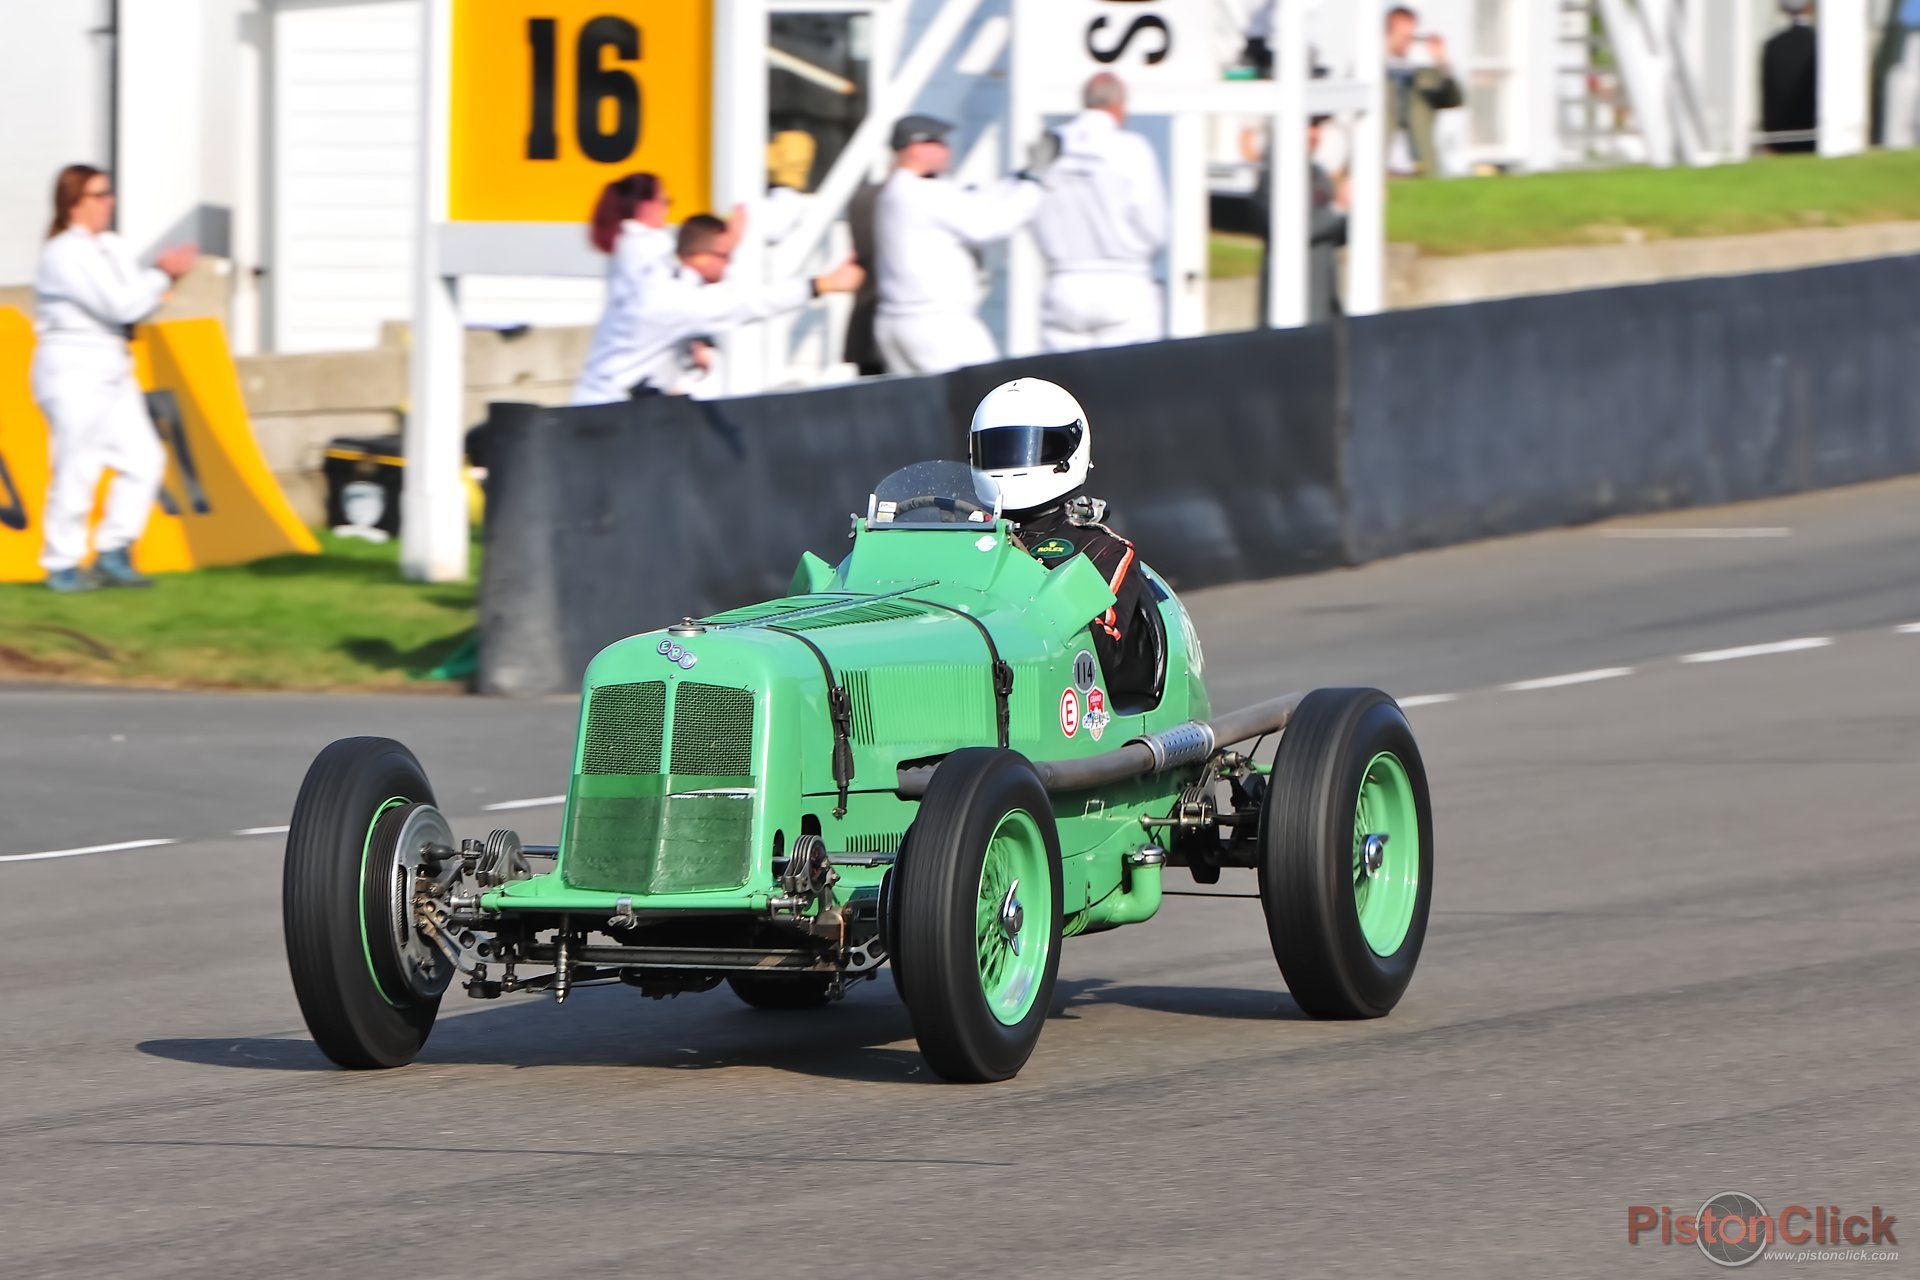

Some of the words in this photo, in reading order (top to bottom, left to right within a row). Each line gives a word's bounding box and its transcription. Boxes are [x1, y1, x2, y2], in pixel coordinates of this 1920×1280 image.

[526, 14, 643, 164] 16
[1076, 661, 1094, 684] 114
[1065, 700, 1074, 726] E
